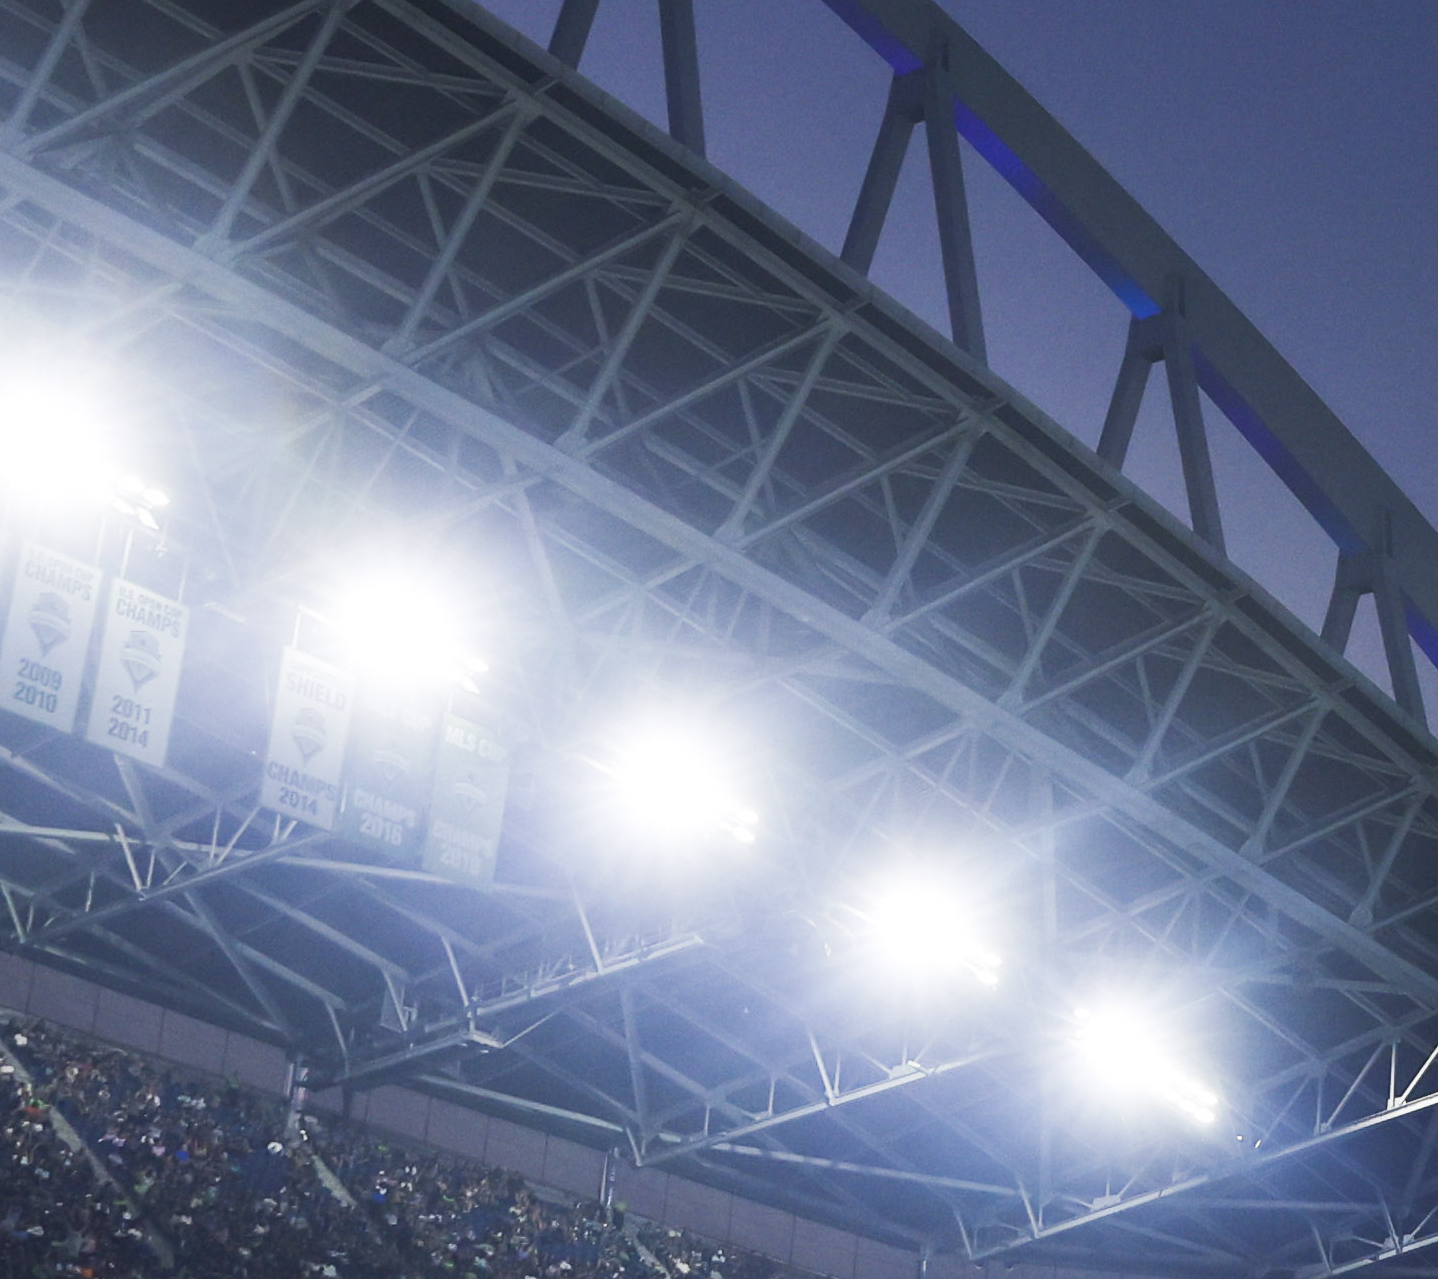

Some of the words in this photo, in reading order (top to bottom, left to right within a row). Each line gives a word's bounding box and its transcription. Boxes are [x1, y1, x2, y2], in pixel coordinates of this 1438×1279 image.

[25, 560, 91, 602] CHAMPS
[116, 598, 181, 638] CHAMPS
[18, 658, 62, 691] 2009
[14, 681, 58, 714] 2010
[287, 673, 347, 710] SHIELD
[113, 694, 152, 724] 2011
[108, 718, 149, 748] 2014
[268, 762, 338, 801] CHAMPS
[279, 786, 318, 815] 2014
